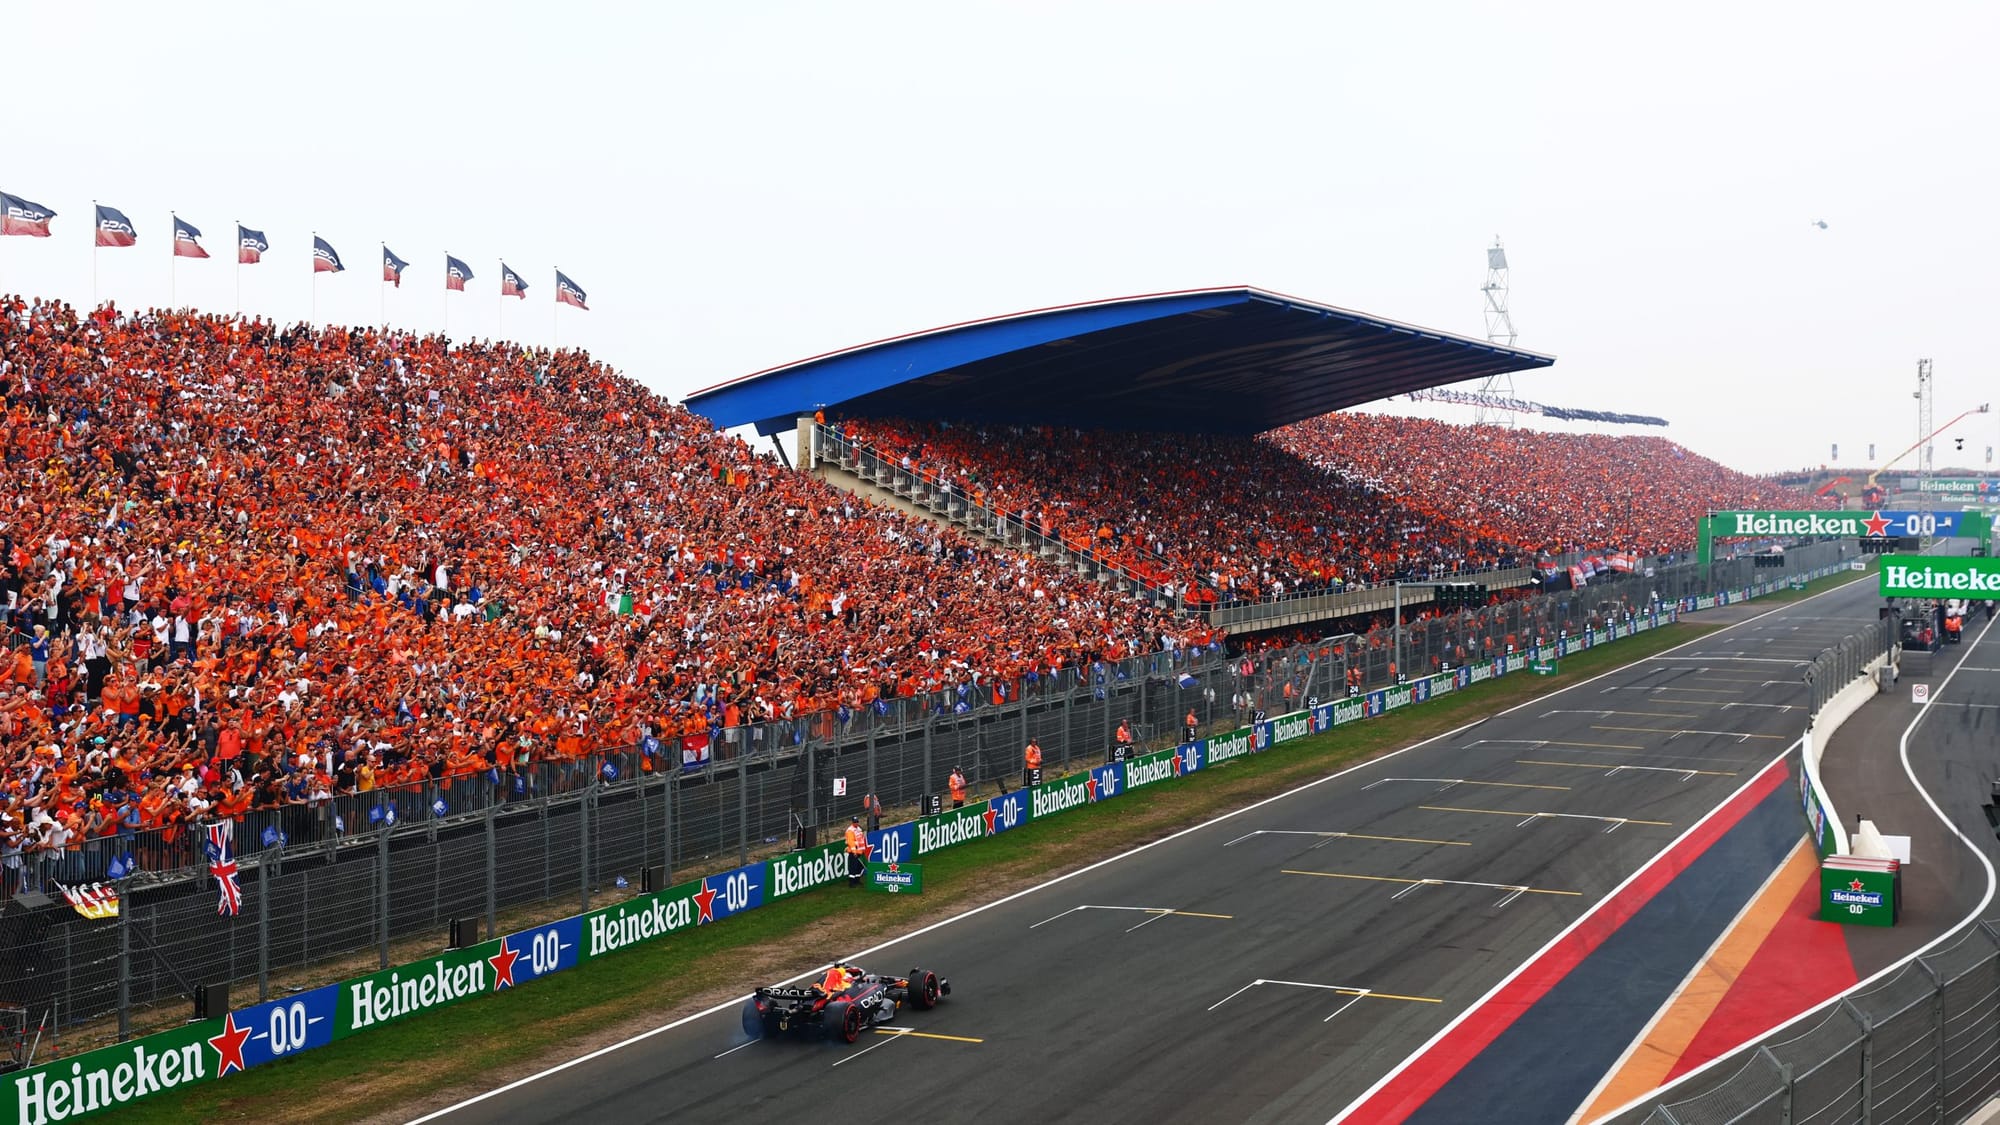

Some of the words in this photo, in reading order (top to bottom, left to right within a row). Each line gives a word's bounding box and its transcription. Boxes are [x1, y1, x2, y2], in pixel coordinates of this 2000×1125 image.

[1920, 481, 1974, 491] Heineken
[1735, 513, 1857, 535] Heineken
[1886, 566, 2000, 591] Heineke
[1334, 701, 1363, 726] Heineken
[1273, 716, 1308, 743] Heineken
[1115, 748, 1124, 756] 20
[1208, 734, 1247, 763] Heineken
[1033, 770, 1039, 779] 5
[1126, 757, 1171, 788] Heineken
[1032, 781, 1085, 818] Heineken
[918, 812, 982, 855] Heineken
[876, 873, 911, 883] Heineken
[1833, 891, 1880, 904] Heineken
[589, 897, 691, 957] Heineken
[726, 871, 748, 912] 0.0
[351, 959, 486, 1030] Heineken
[532, 929, 559, 975] 0.0
[762, 987, 812, 997] ORACLE
[15, 1041, 205, 1125] Heineken
[270, 1001, 306, 1055] 0.0
